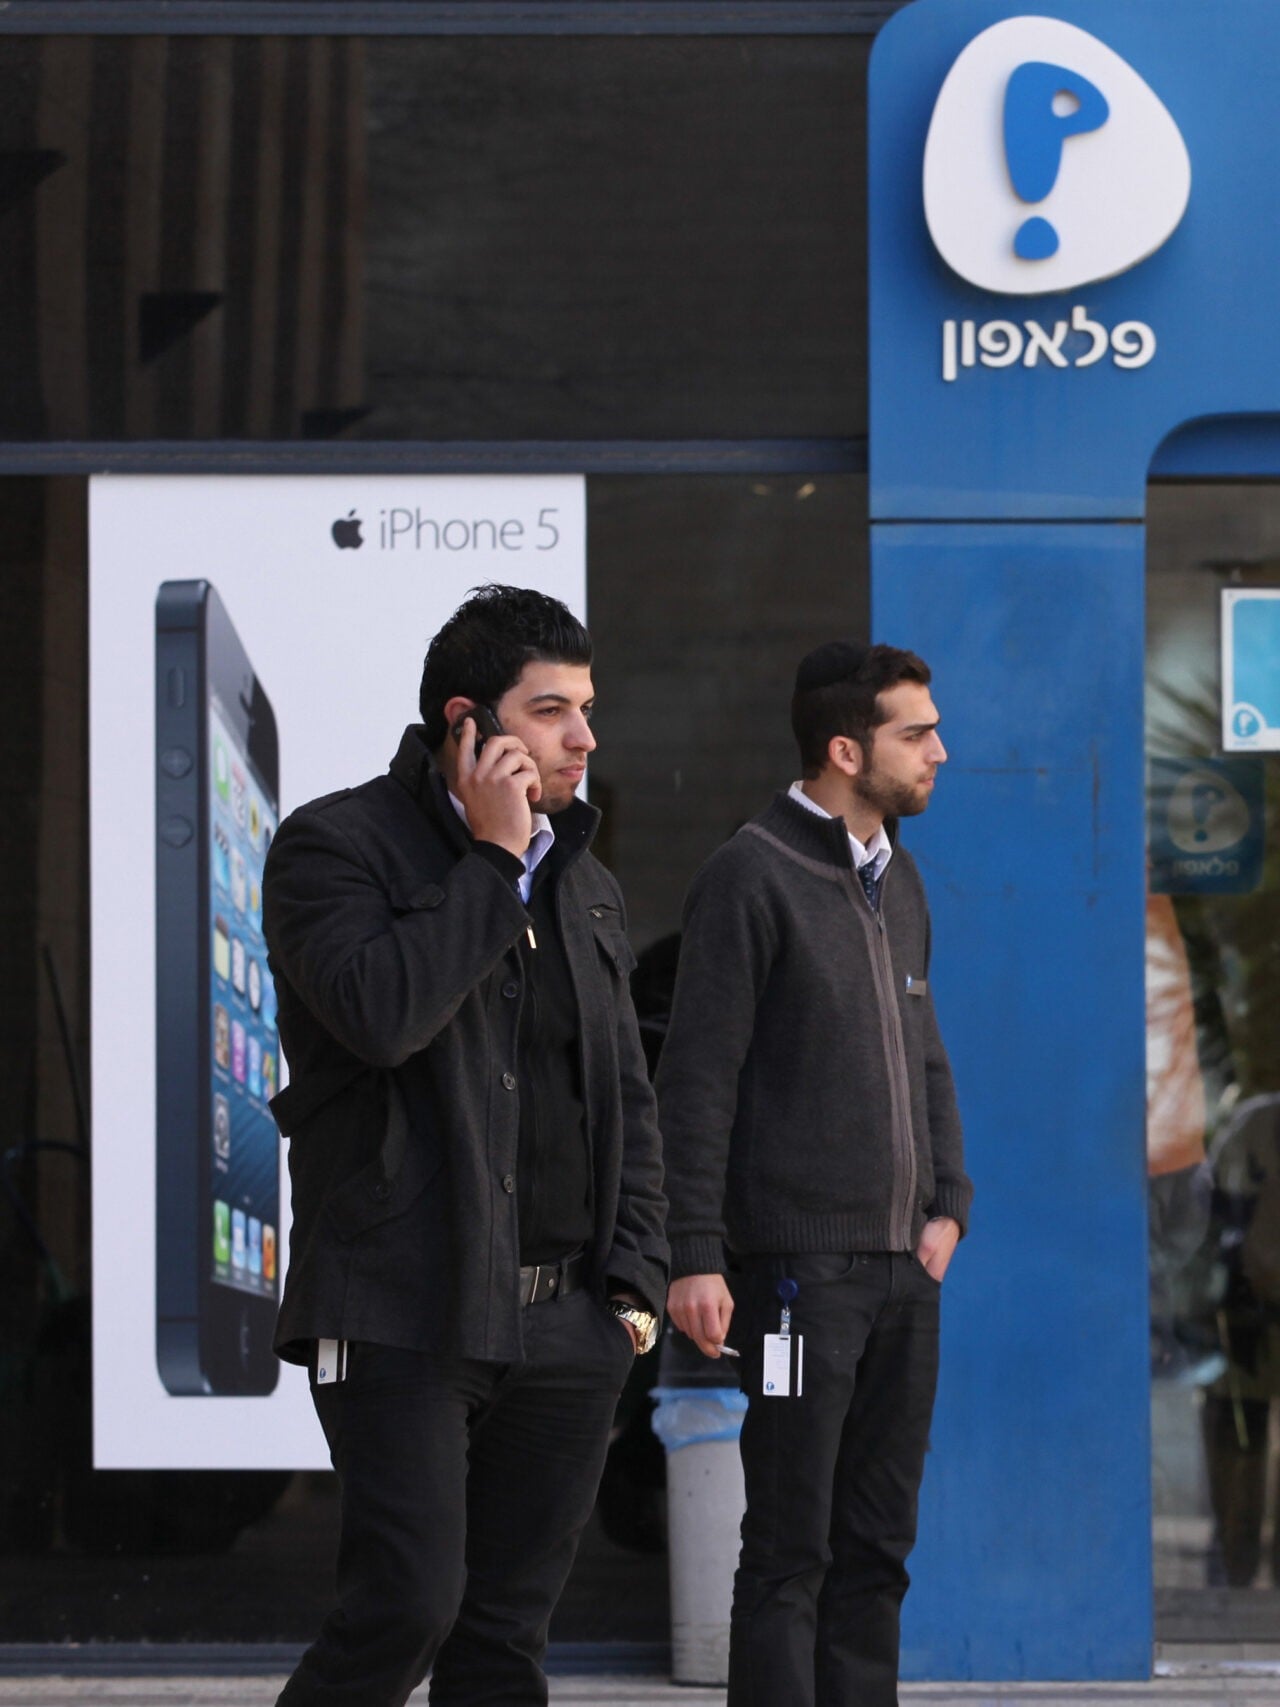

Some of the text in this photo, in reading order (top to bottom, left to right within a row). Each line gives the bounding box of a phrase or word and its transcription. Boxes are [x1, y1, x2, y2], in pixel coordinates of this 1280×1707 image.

[943, 305, 1157, 382] פלאפון
[380, 508, 559, 550] iPhone 5
